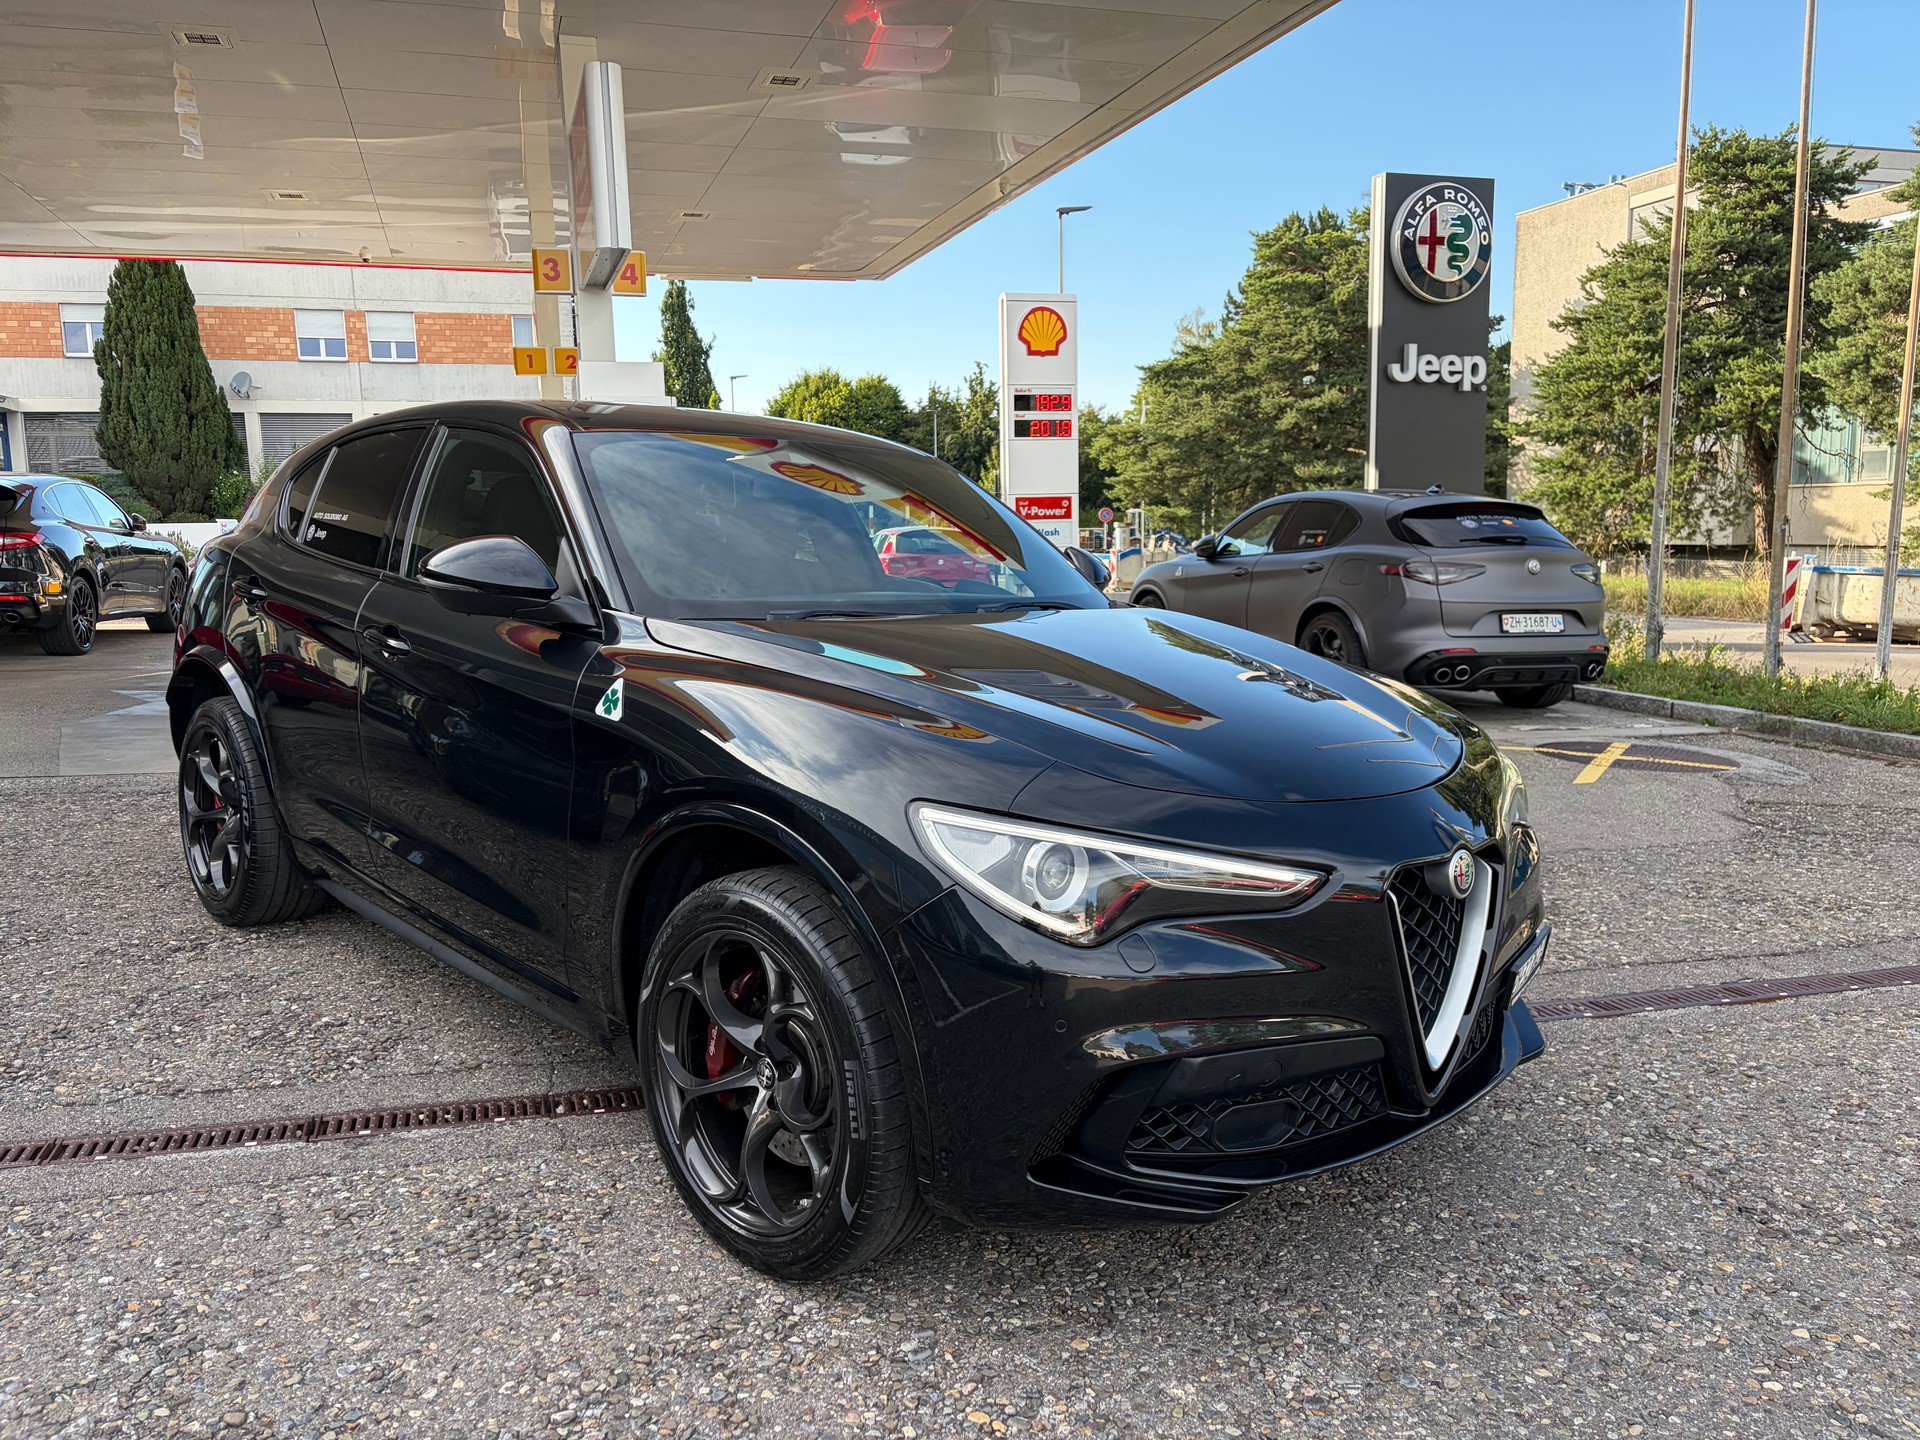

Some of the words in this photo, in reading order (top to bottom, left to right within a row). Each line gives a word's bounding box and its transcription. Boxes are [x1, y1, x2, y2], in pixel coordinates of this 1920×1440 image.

[1404, 194, 1437, 241] ALFA
[1444, 189, 1489, 245] ROMEO
[542, 257, 561, 282] 3
[619, 263, 639, 286] 4
[526, 353, 534, 369] 1
[565, 354, 577, 370] 2
[1387, 343, 1487, 391] Jeep
[1019, 506, 1067, 517] V-Power
[844, 1060, 866, 1140] PIRELLI
